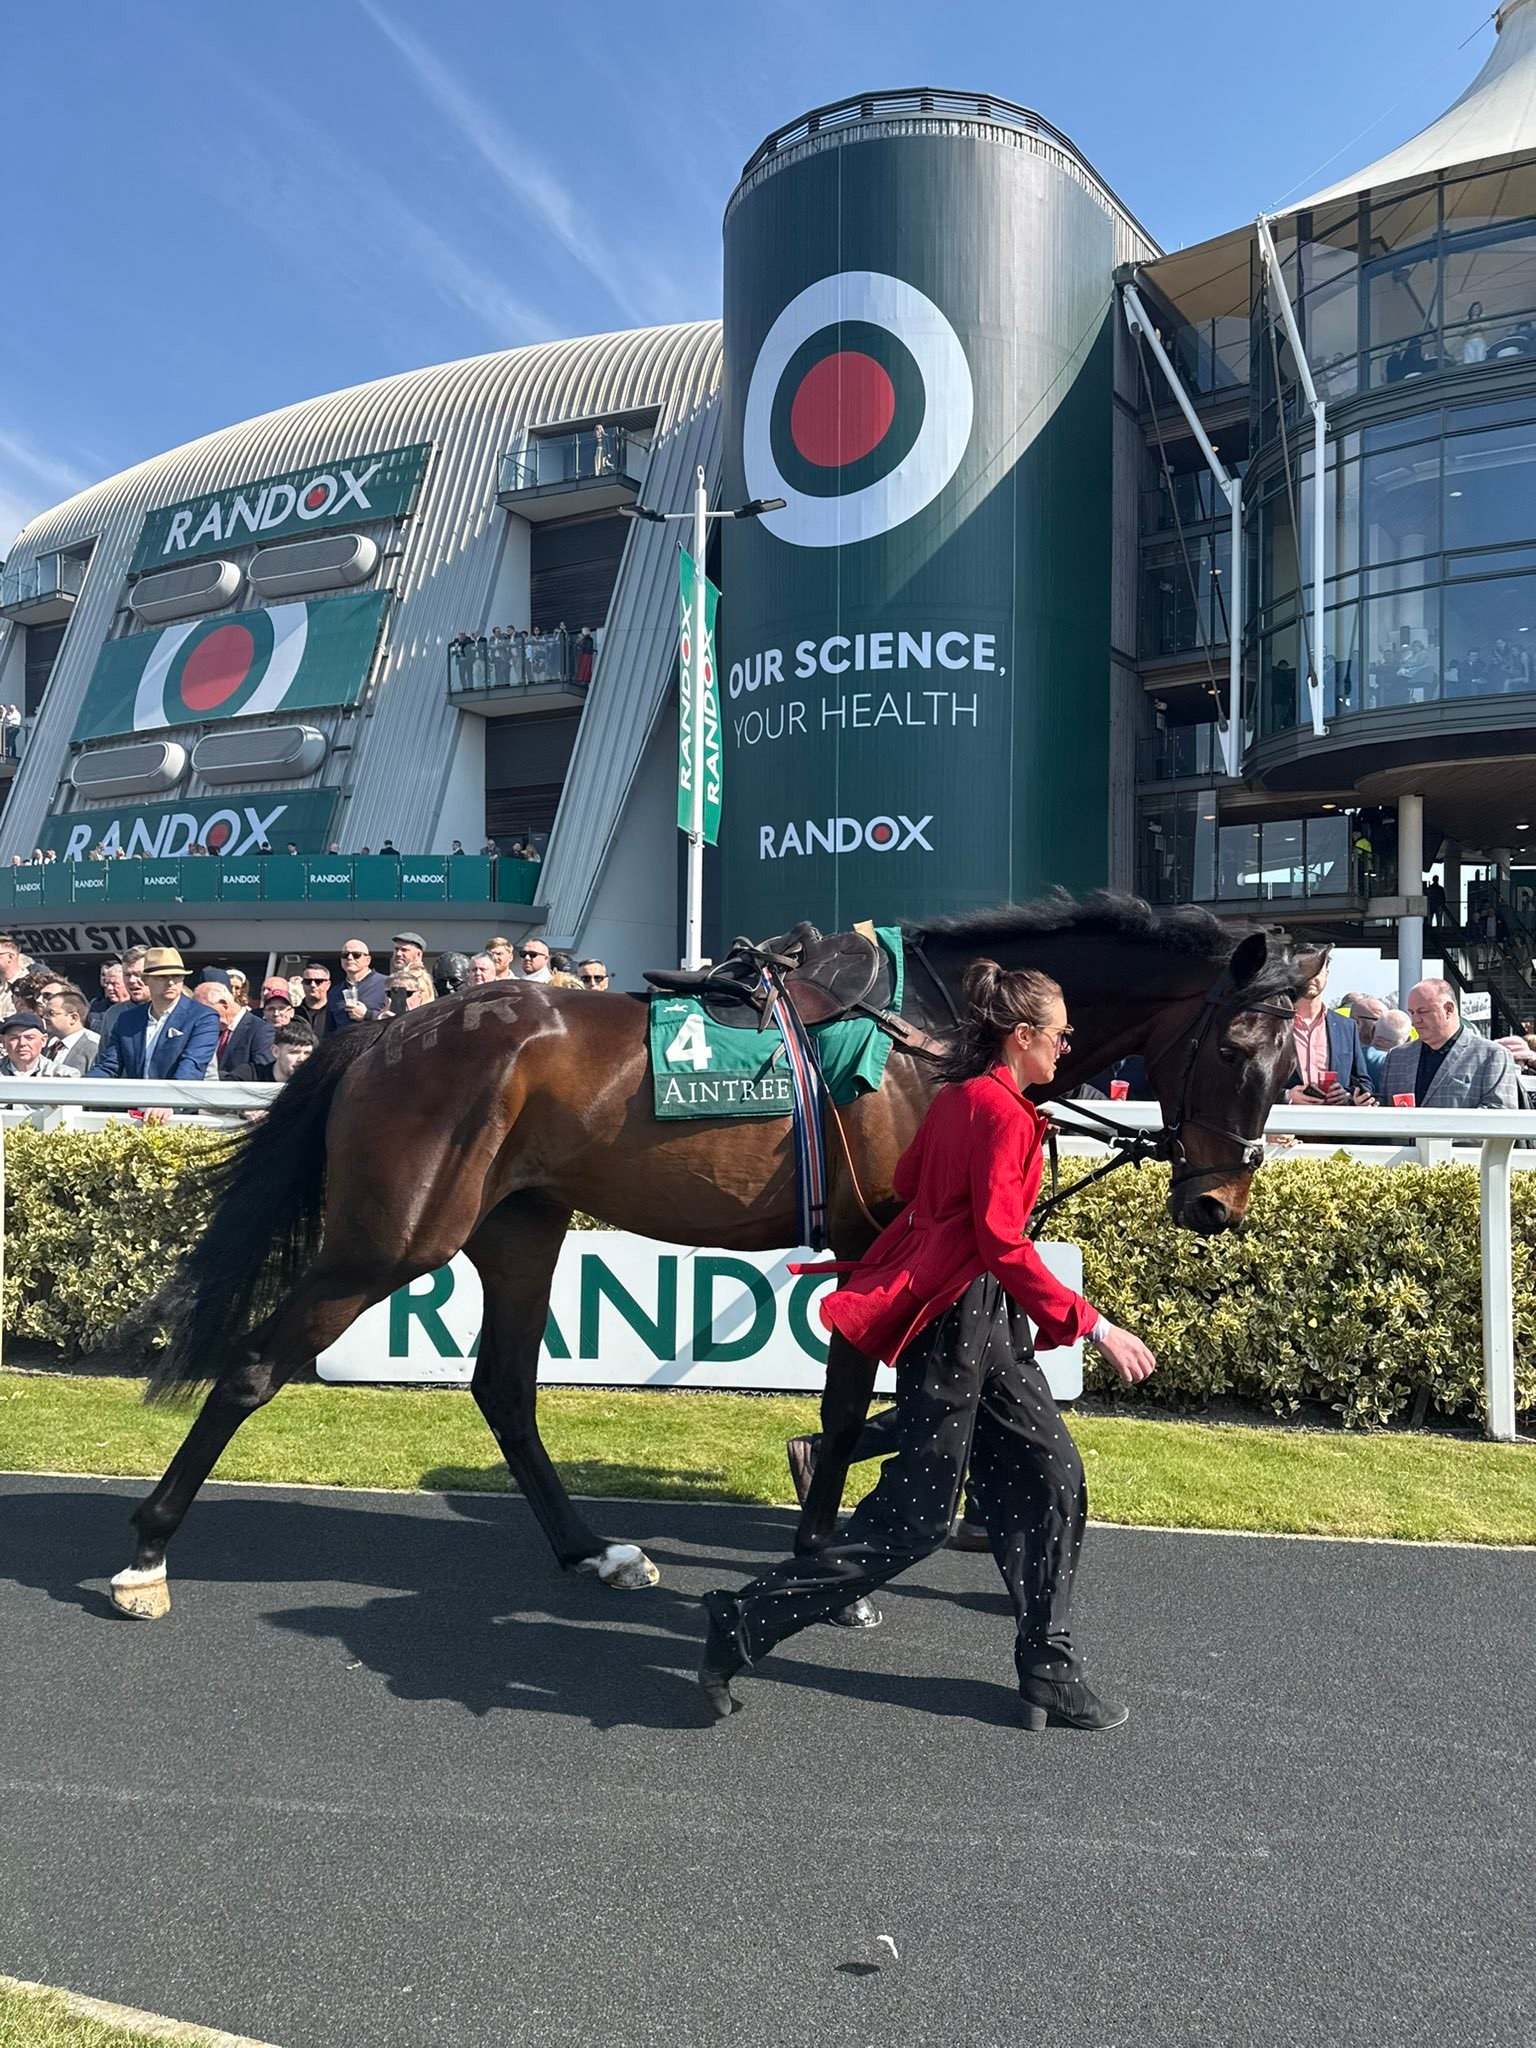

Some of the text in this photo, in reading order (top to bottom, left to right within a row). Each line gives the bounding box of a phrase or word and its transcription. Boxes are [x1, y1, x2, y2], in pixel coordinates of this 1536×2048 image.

[162, 462, 383, 555] RANDOX
[729, 631, 1006, 699] OUR SCIENCE,
[681, 595, 692, 791] RANDOX
[733, 691, 977, 748] YOUR HEALTH
[63, 805, 288, 863] RANDOX
[760, 815, 934, 860] RANDOX
[16, 882, 41, 892] RANDOX
[75, 879, 104, 888] RANDOX
[144, 876, 178, 885] RANDOX
[223, 875, 260, 884] RANDOX
[310, 874, 350, 883] RANDOX
[403, 874, 444, 883] RANDOX
[7, 924, 196, 953] ERBY STAND
[666, 1014, 712, 1070] 4
[663, 1078, 790, 1104] AINTREE
